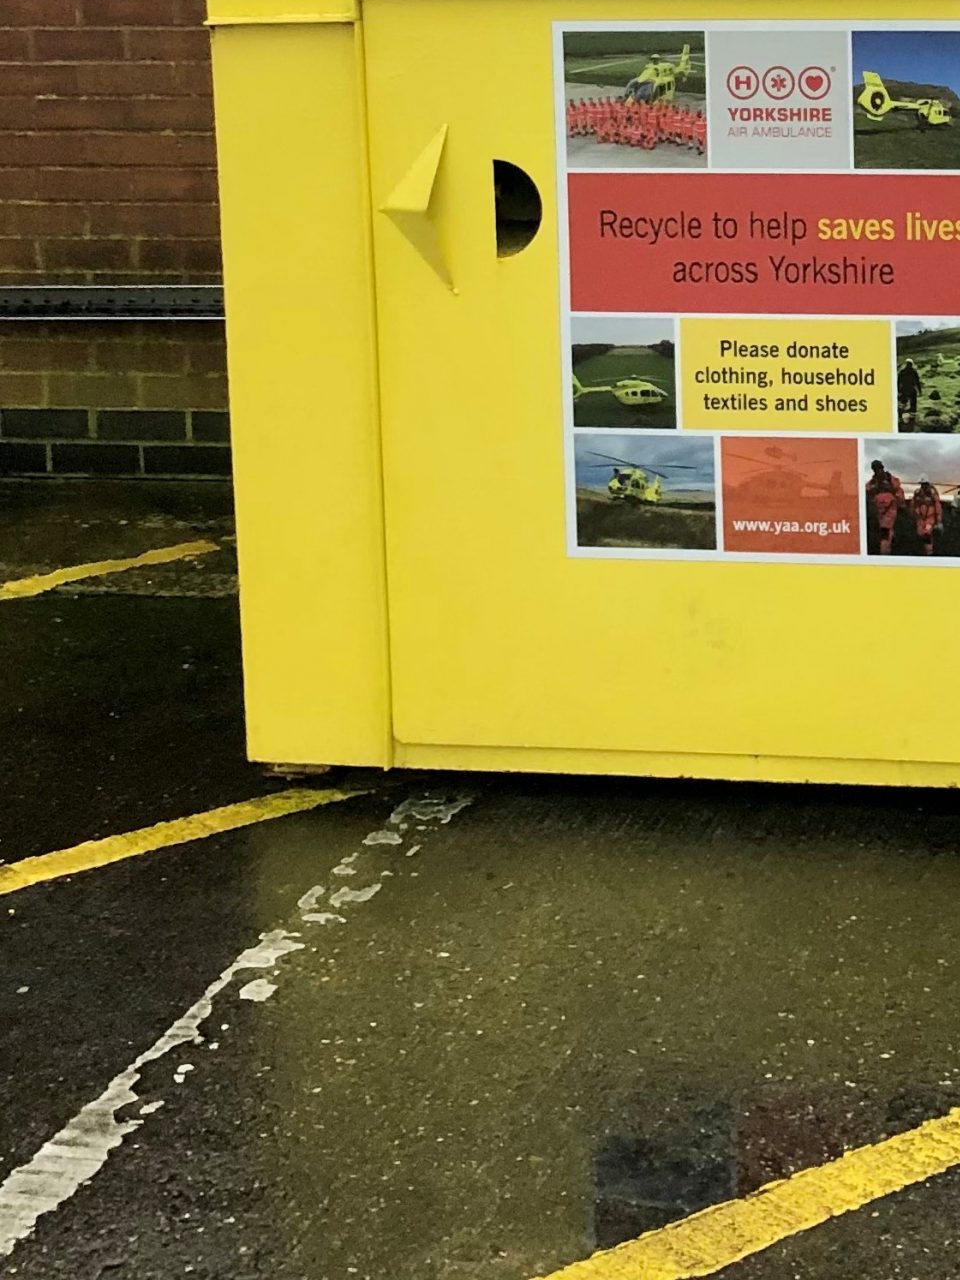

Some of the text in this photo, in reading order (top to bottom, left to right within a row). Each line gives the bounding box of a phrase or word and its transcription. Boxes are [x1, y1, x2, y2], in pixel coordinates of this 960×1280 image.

[727, 107, 833, 122] YORKSHIRE
[727, 126, 833, 138] AIR AMBULANCE
[600, 209, 702, 245] Recycle
[712, 212, 738, 239] to
[750, 211, 808, 246] help
[817, 217, 895, 241] saves
[672, 255, 895, 285] across Yorkshire
[720, 340, 849, 359] Please donate
[694, 366, 875, 388] clothing, household
[703, 393, 868, 412] textiles and shoes
[733, 519, 851, 536] www.yaa.org.uk
